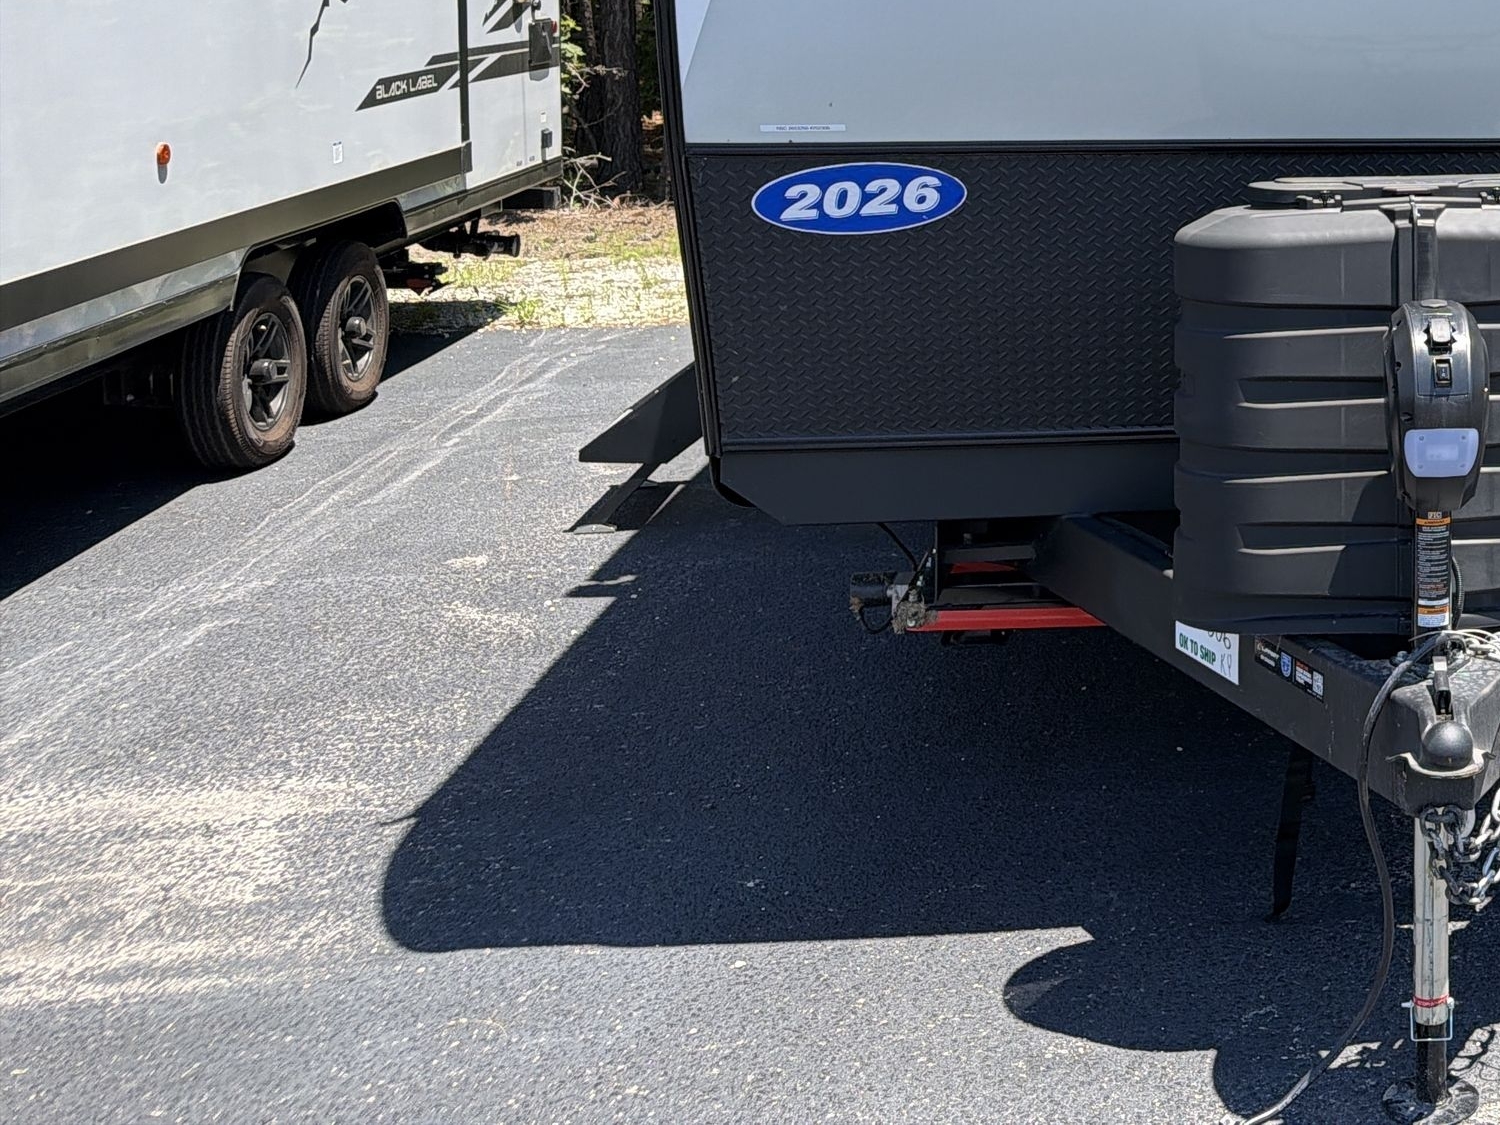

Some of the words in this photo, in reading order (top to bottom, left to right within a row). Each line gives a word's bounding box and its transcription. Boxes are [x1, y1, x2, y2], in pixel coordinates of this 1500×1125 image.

[376, 79, 407, 99] BLACK
[409, 74, 438, 92] LABEL
[779, 175, 943, 222] 2026
[1179, 632, 1189, 651] OK
[1190, 639, 1198, 656] TO
[1200, 644, 1216, 665] SHIP
